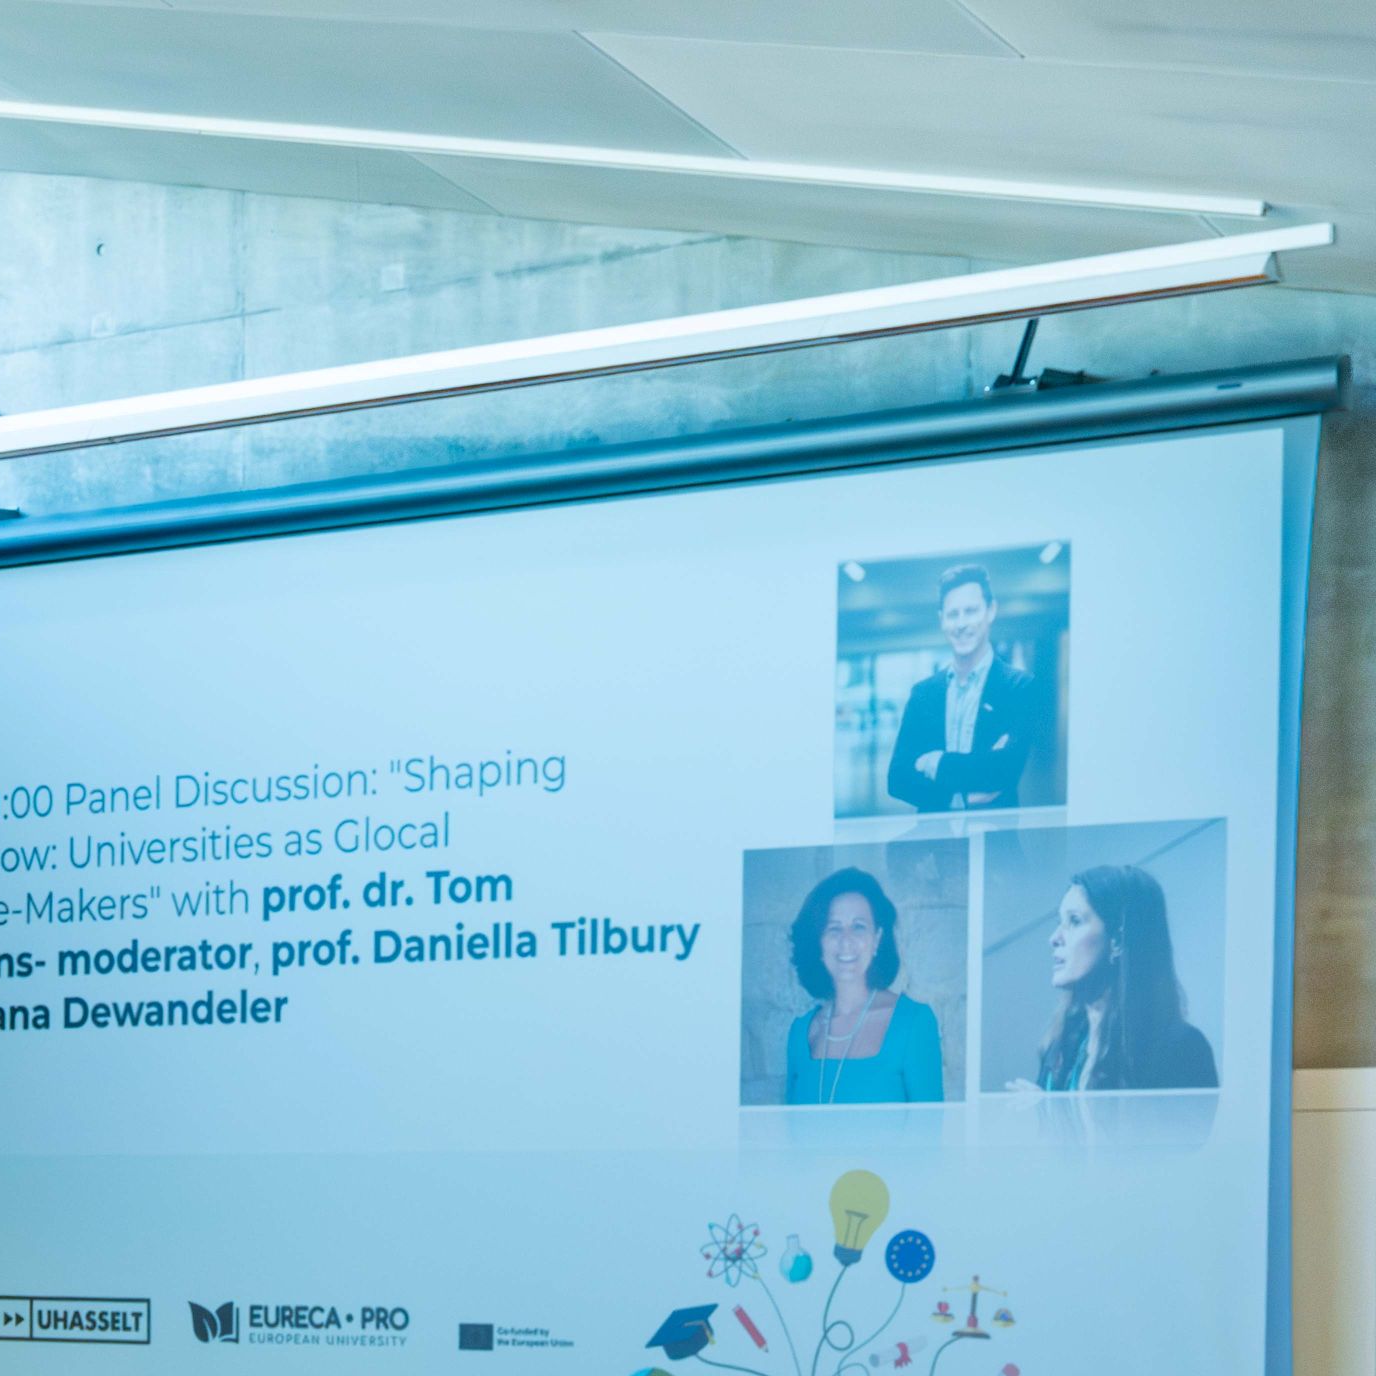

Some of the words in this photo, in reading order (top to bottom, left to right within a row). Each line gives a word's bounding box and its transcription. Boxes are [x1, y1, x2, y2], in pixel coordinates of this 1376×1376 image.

[66, 775, 160, 816] Panel
[175, 763, 377, 808] Discussion:
[390, 750, 566, 797] "Shaping
[69, 824, 273, 869] Universities
[284, 829, 323, 857] as
[334, 811, 449, 853] Glocal
[171, 879, 249, 917] with
[262, 873, 351, 922] prof.
[362, 871, 414, 908] dr.
[425, 869, 513, 905] Tom
[58, 938, 259, 977] moderator,
[272, 928, 360, 977] prof.
[373, 921, 537, 964] Daniella
[550, 916, 701, 962] Tilbury
[63, 988, 289, 1029] Dewandeler
[37, 1309, 143, 1332] UHASSELT
[249, 1305, 342, 1330] EURECA
[360, 1306, 410, 1331] PRO
[249, 1332, 320, 1346] EUROPEAN
[325, 1333, 408, 1347] UNIVERSITY
